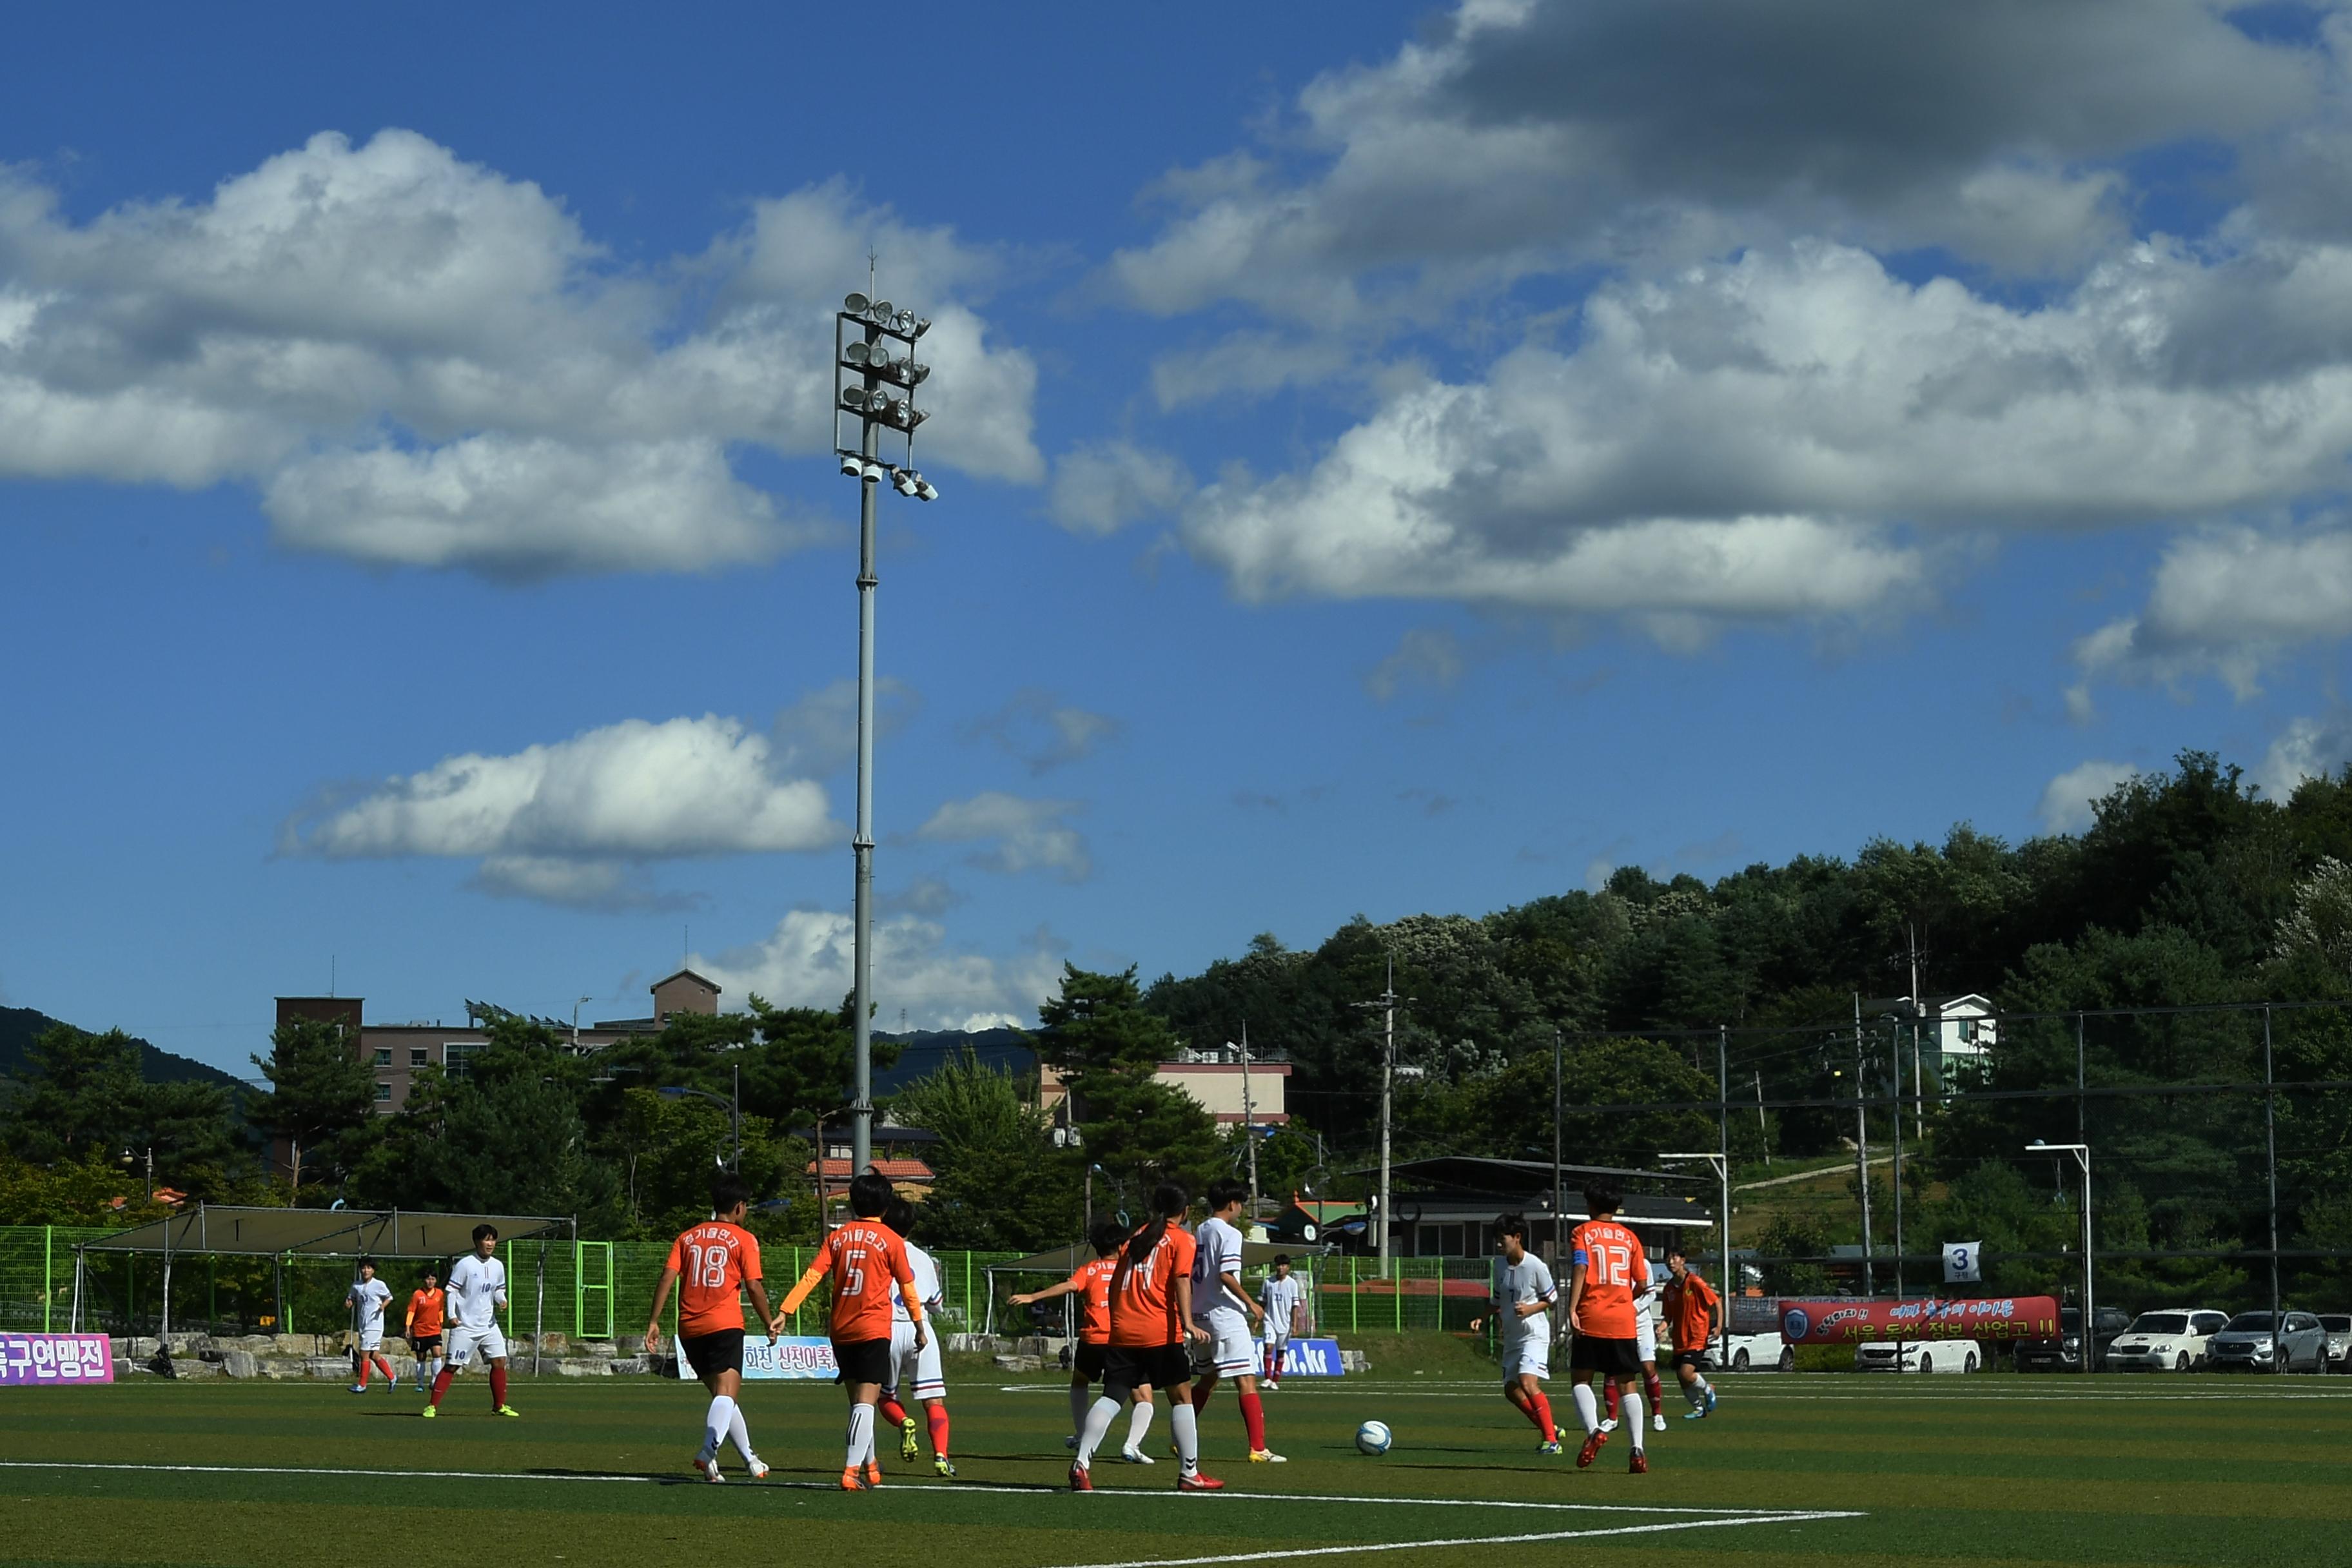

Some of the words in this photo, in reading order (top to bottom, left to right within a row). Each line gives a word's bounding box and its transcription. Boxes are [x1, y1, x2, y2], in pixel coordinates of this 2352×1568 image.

[689, 1244, 727, 1287] 18
[1591, 1244, 1630, 1286] 12
[1952, 1248, 1968, 1270] 3
[841, 1250, 867, 1296] 5
[481, 1282, 491, 1293] 10
[1890, 1304, 1919, 1319] 여자
[1968, 1300, 2014, 1317] 아이콘
[1842, 1325, 1877, 1342] 서울
[1885, 1323, 1920, 1340] 동산
[1929, 1321, 1965, 1339] 정보
[1973, 1320, 2030, 1339] 산업고
[2039, 1319, 2053, 1337] !!
[455, 1349, 466, 1360] 10
[745, 1346, 773, 1371] 화천
